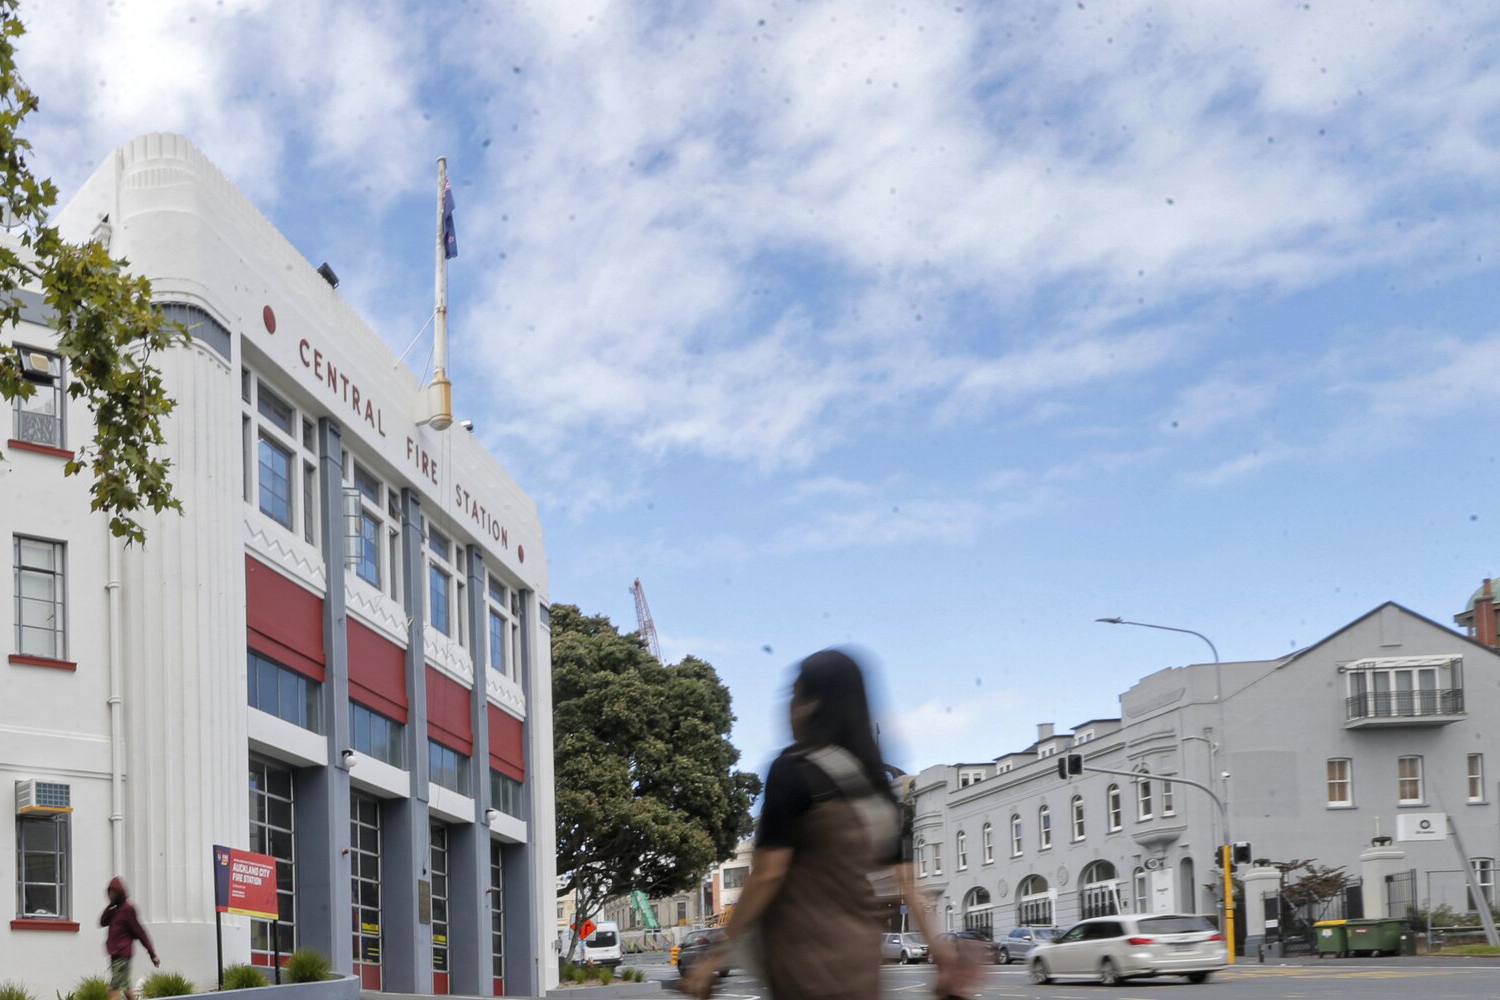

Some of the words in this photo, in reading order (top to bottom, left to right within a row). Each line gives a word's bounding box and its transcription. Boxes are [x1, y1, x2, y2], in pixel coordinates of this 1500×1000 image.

[299, 338, 386, 437] CENTRAL
[406, 435, 438, 485] FIRE
[455, 484, 509, 550] STATION
[233, 863, 258, 875] AUCKLAND
[259, 868, 270, 878] CITY
[233, 872, 243, 882] FIRE
[244, 874, 262, 885] STATION
